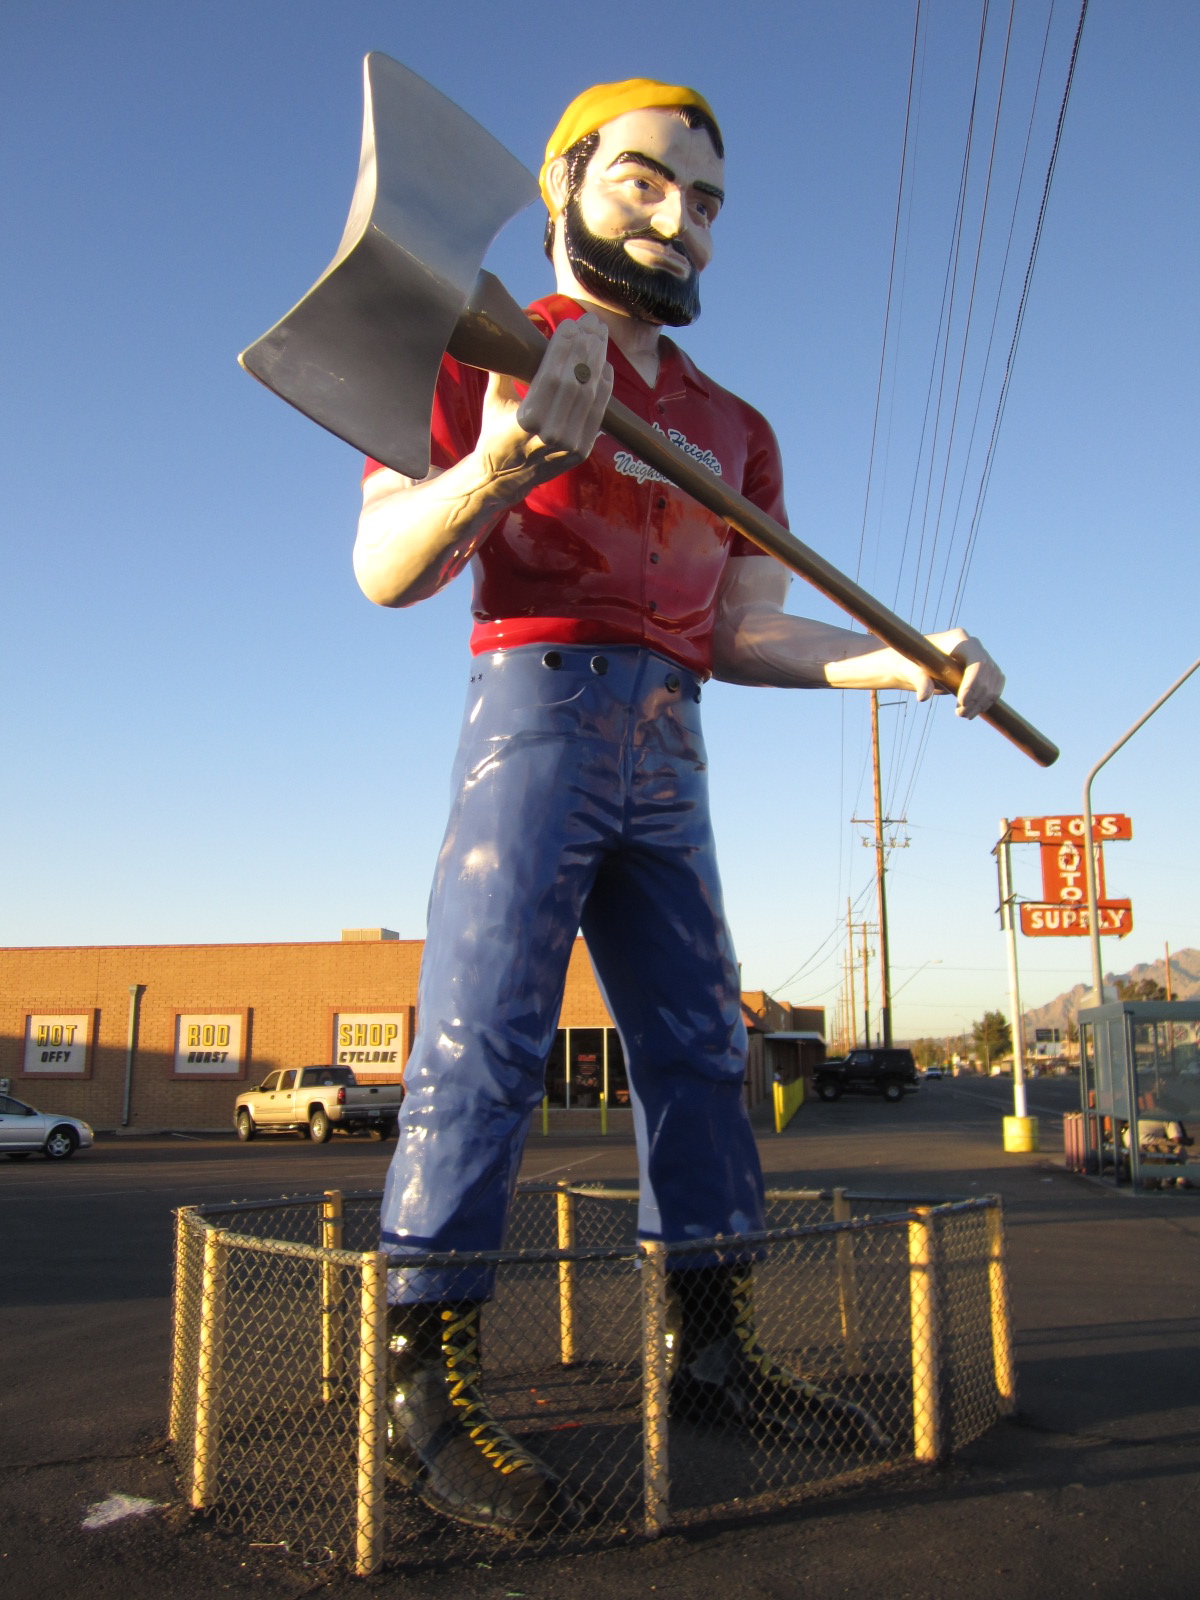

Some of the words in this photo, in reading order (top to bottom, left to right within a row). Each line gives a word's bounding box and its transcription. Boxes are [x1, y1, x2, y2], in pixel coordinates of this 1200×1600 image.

[669, 429, 721, 475] Heights
[1024, 816, 1119, 837] LEO'S
[1057, 840, 1083, 901] AUTO
[37, 1025, 78, 1046] HOT
[187, 1024, 231, 1047] ROD
[339, 1023, 398, 1047] SHOP
[40, 1050, 71, 1063] OFFY
[338, 1051, 398, 1064] CYCLONE
